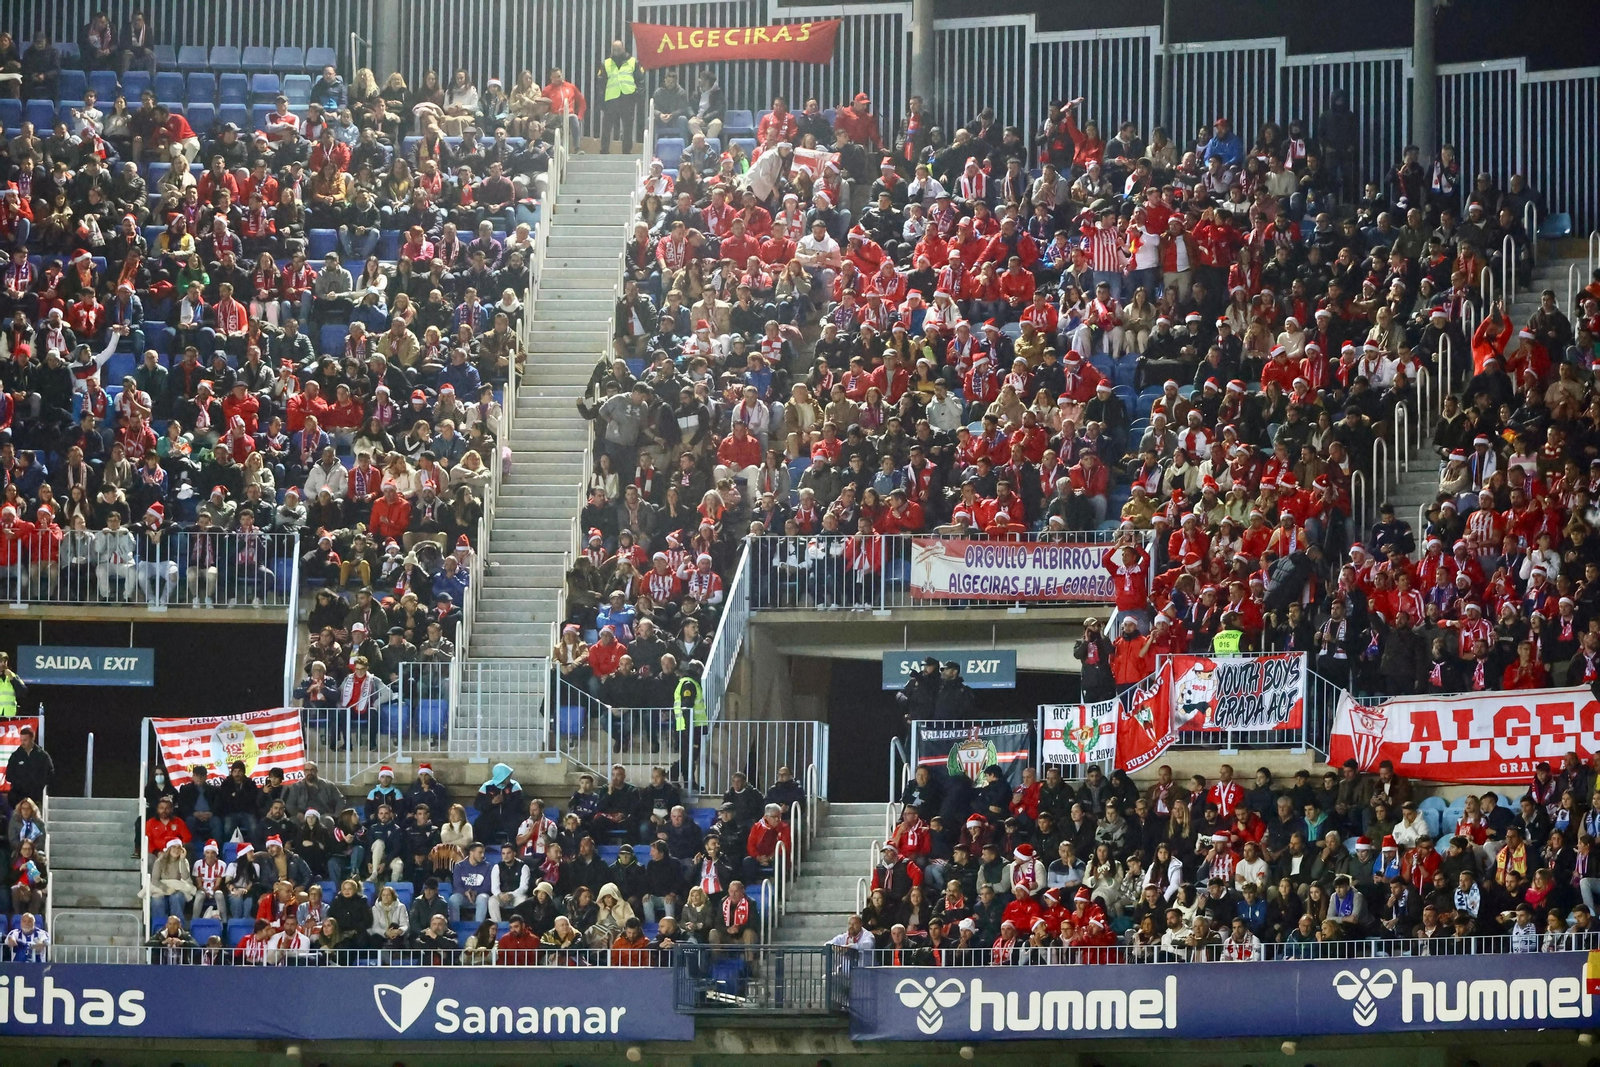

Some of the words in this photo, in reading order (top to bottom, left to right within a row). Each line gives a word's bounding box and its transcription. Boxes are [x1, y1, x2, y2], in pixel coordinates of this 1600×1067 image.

[657, 23, 812, 53] ALGECIRAS
[965, 545, 1026, 569] ORGULLO
[950, 573, 1019, 595] ALGECIRAS
[1025, 576, 1041, 596] EN
[1045, 576, 1058, 596] EL
[1063, 575, 1116, 596] CORAZO
[35, 655, 92, 670] SALIDA
[103, 657, 138, 671] EXIT
[966, 660, 1000, 674] EXIT
[1216, 662, 1261, 698] YOUTH
[1263, 656, 1300, 692] BOYS
[1053, 708, 1071, 720] ACF
[1091, 701, 1114, 718] FANS
[1215, 695, 1265, 726] GRADA
[1267, 689, 1298, 723] ACF
[920, 729, 967, 741] VALIENTE
[978, 722, 1029, 736] LUCHADOR
[1051, 730, 1061, 738] 19
[1102, 724, 1112, 733] 12
[1048, 753, 1078, 763] BARRIO
[970, 975, 1177, 1032] hummel
[1402, 962, 1593, 1023] hummel
[434, 998, 626, 1034] Sanamar
